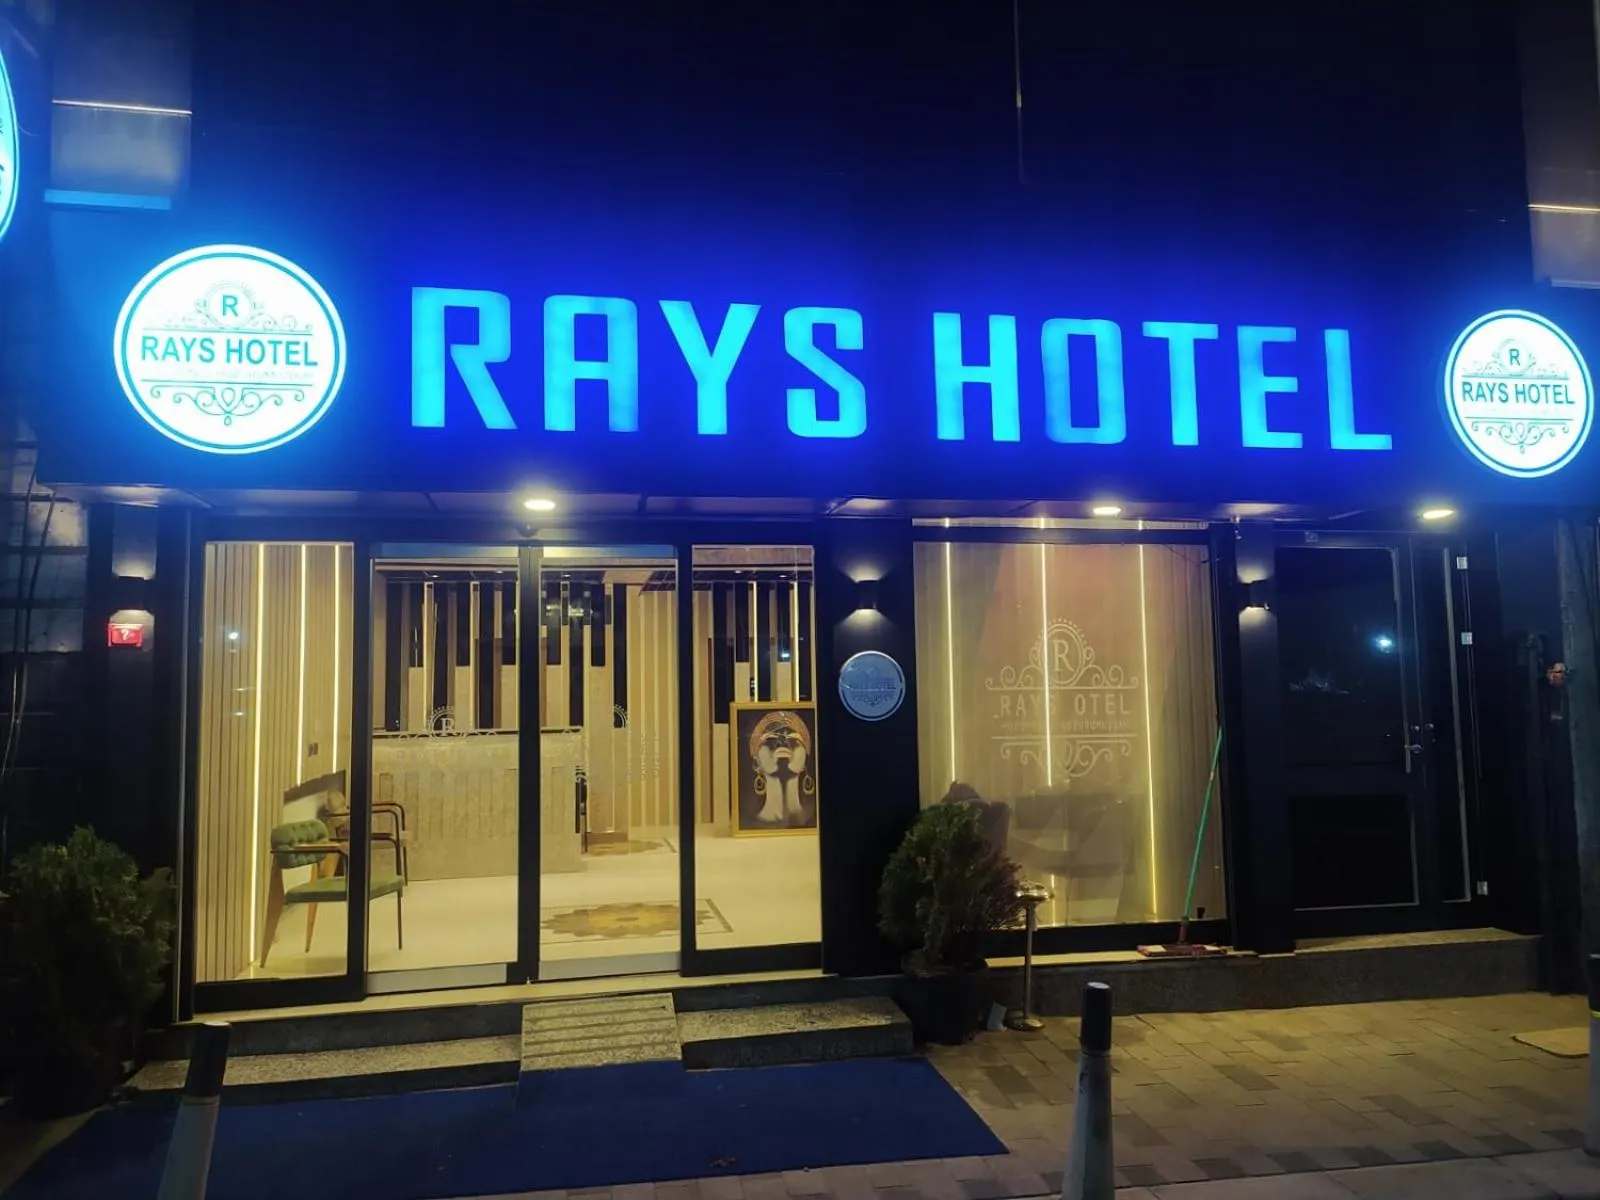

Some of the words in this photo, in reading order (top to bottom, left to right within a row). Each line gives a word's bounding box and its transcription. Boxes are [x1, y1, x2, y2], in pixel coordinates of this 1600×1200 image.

[222, 294, 239, 317] R
[141, 335, 216, 364] RAYS
[225, 338, 319, 367] HOTEL
[1509, 348, 1521, 367] R
[411, 286, 867, 439] RAYS
[933, 311, 1393, 450] HOTEL
[1462, 381, 1509, 403] RAYS
[1515, 383, 1575, 405] HOTEL
[1052, 639, 1075, 672] R
[1074, 693, 1132, 716] OTEL
